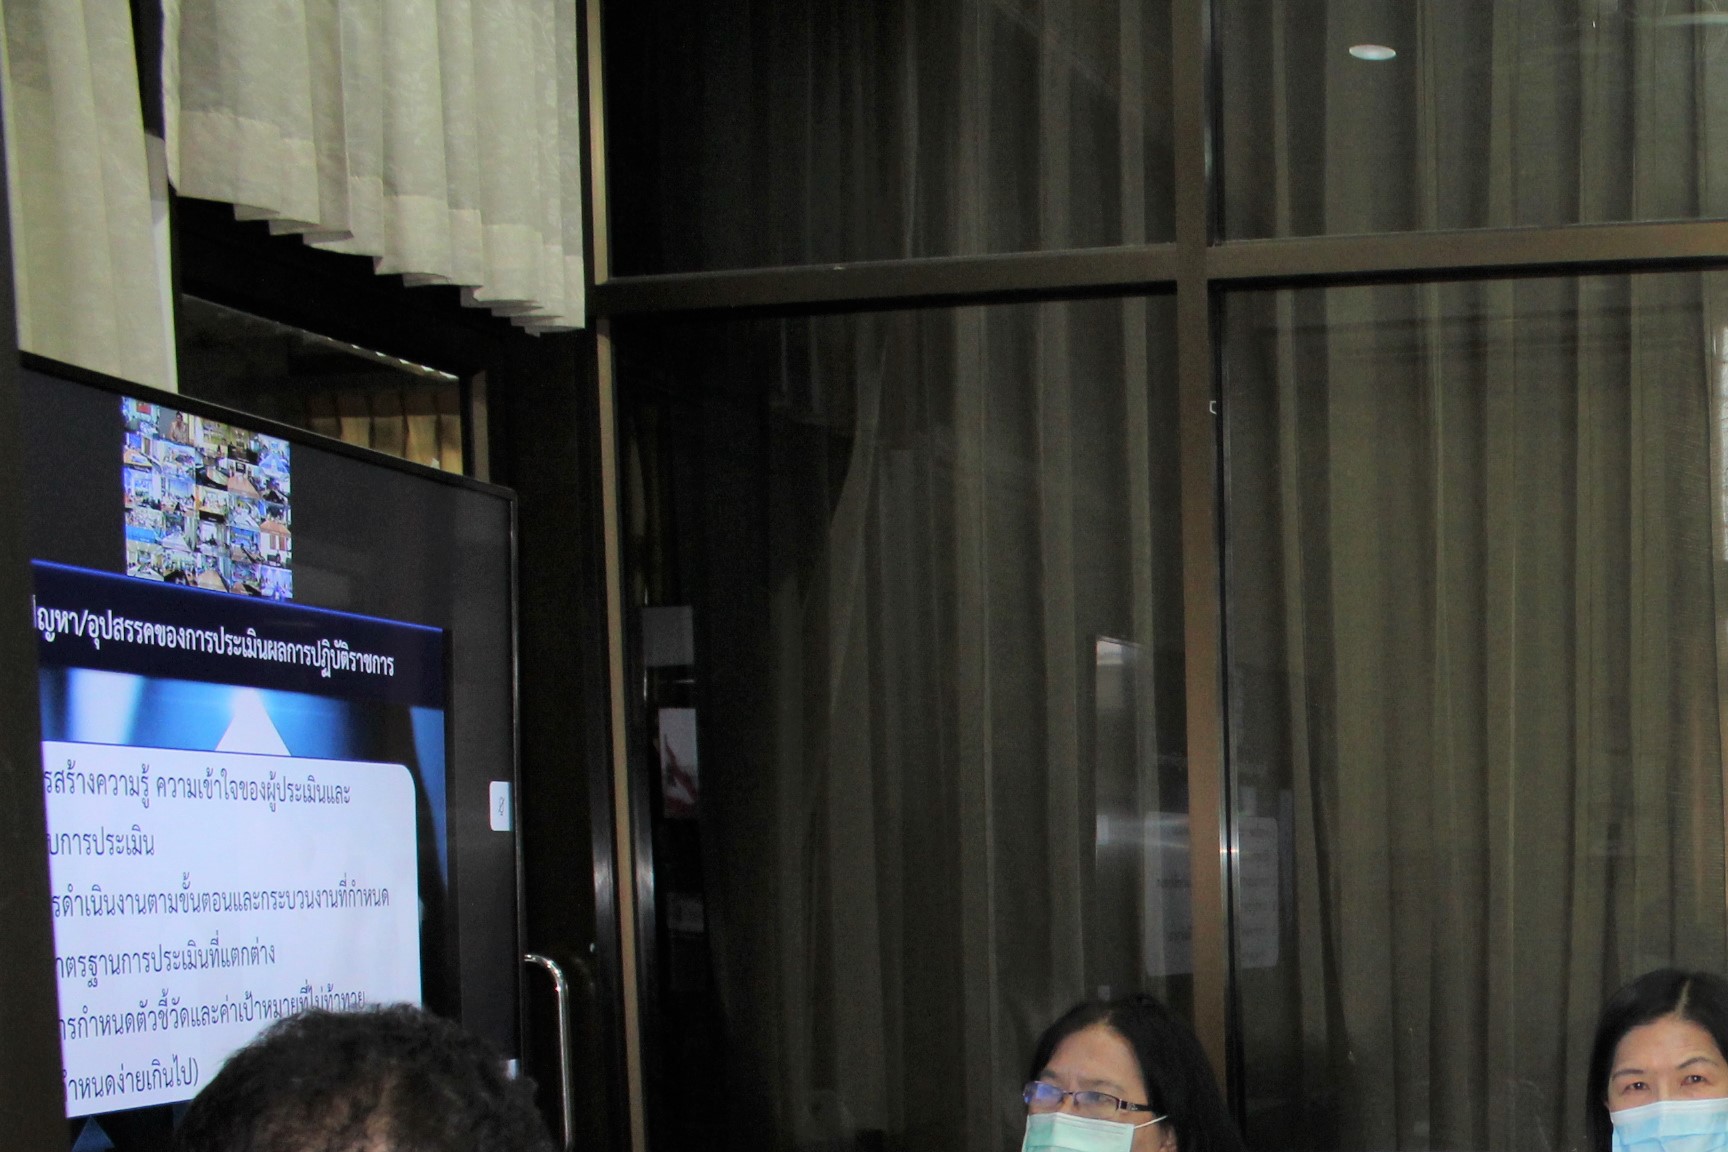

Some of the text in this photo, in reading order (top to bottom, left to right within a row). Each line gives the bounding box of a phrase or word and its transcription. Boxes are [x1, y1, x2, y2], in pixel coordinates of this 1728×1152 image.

[32, 594, 396, 678] ญหา/อุปสรรคของการประเมินผลการปฏิบัติราชการ
[156, 767, 351, 813] ความเข้าใจของผู้ประเมินและ
